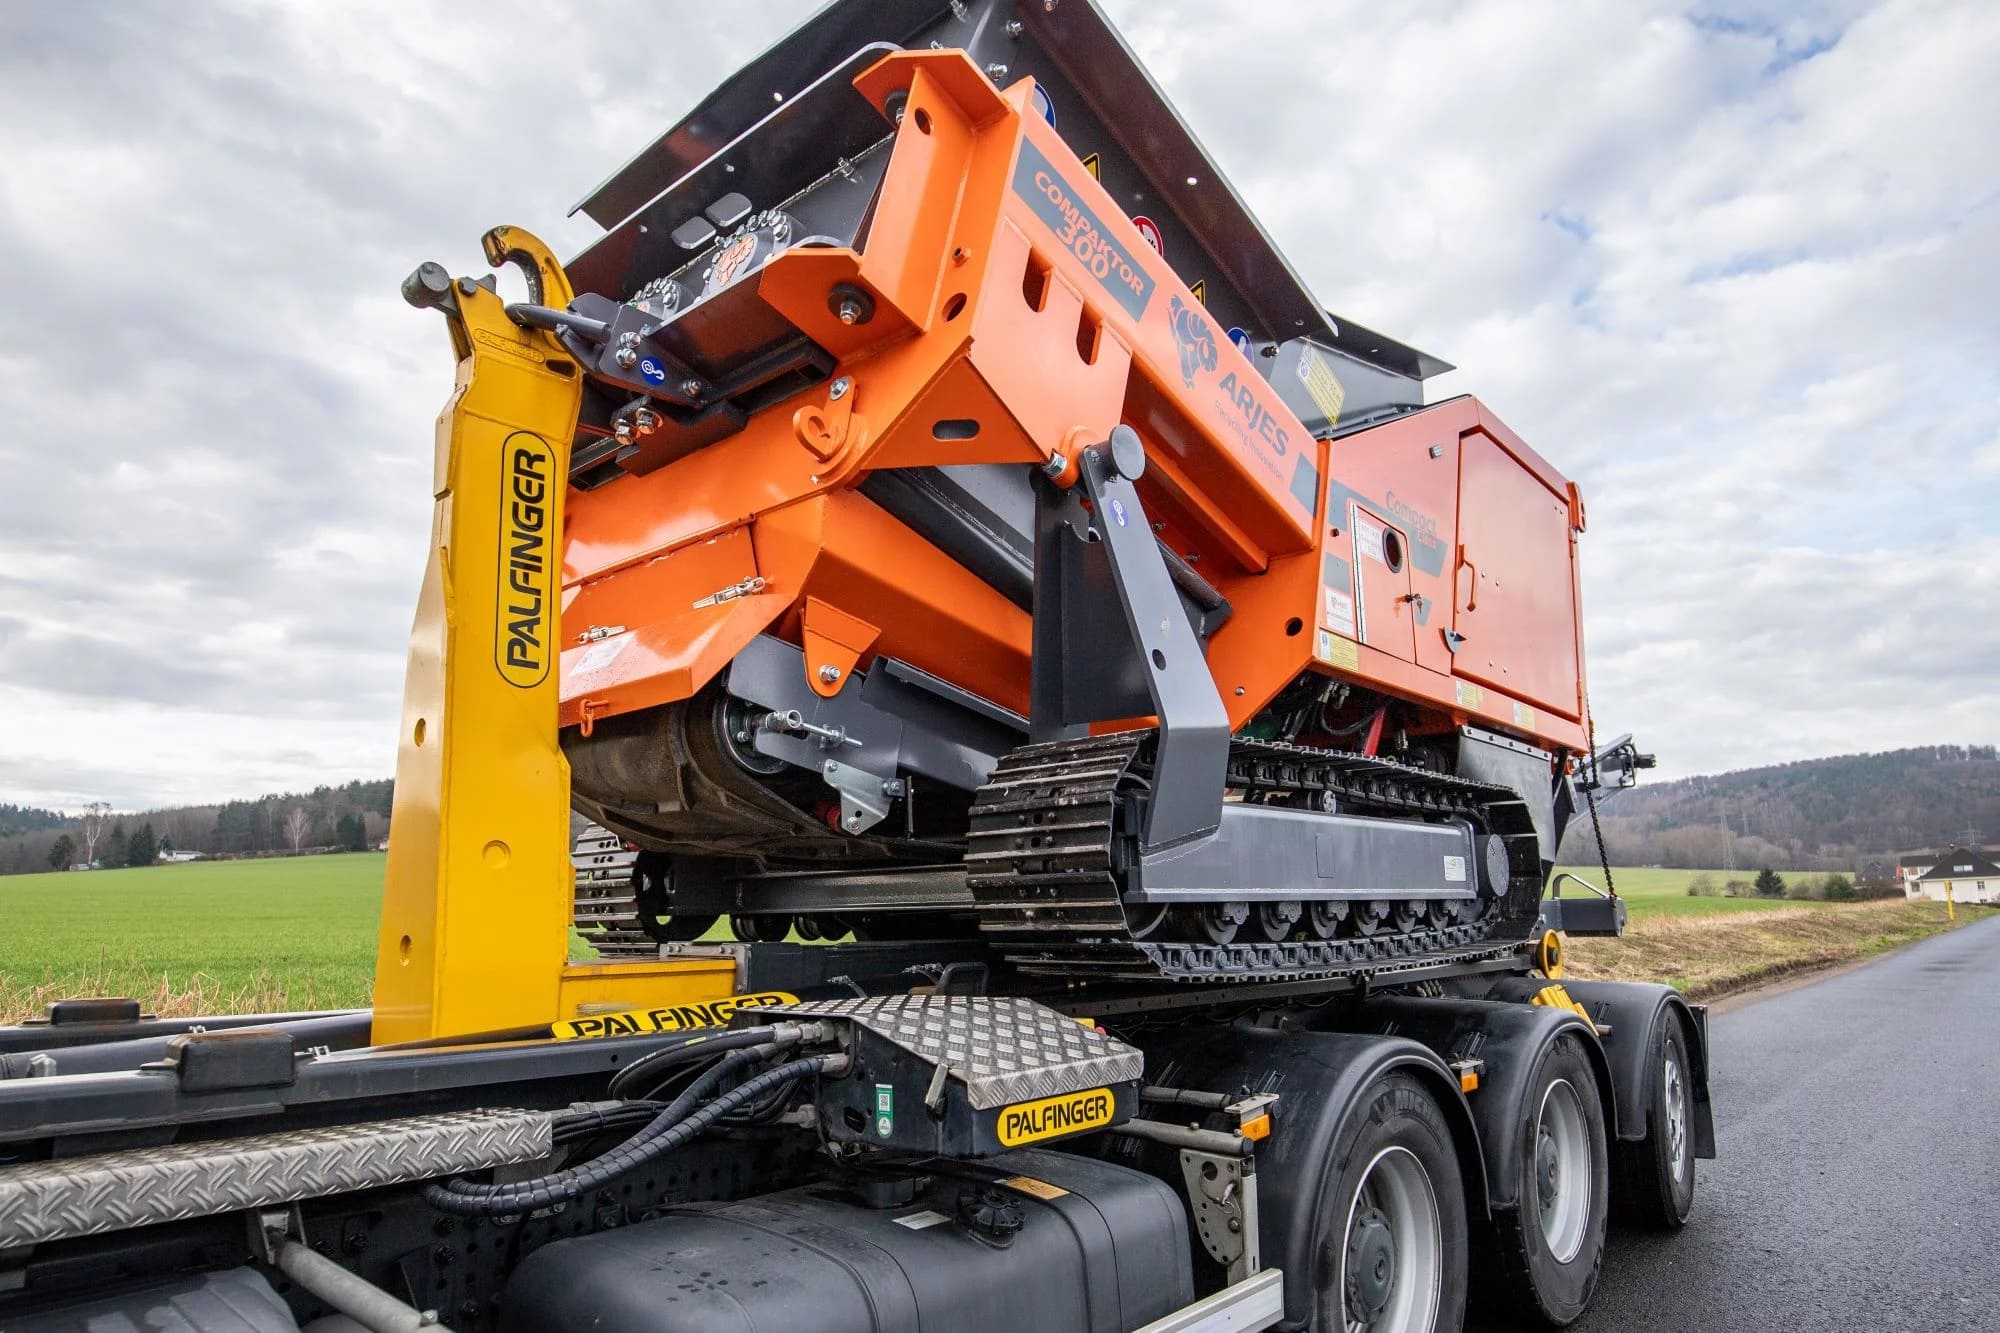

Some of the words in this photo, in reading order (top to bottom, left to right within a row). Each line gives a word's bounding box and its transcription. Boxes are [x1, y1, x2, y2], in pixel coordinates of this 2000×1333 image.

[1035, 171, 1144, 297] COMPAKTOR
[1055, 215, 1109, 279] 300
[1219, 371, 1289, 457] ARJES
[1386, 490, 1436, 534] Compact
[506, 448, 546, 670] PALFINGER
[1006, 1095, 1108, 1140] PALFINGER
